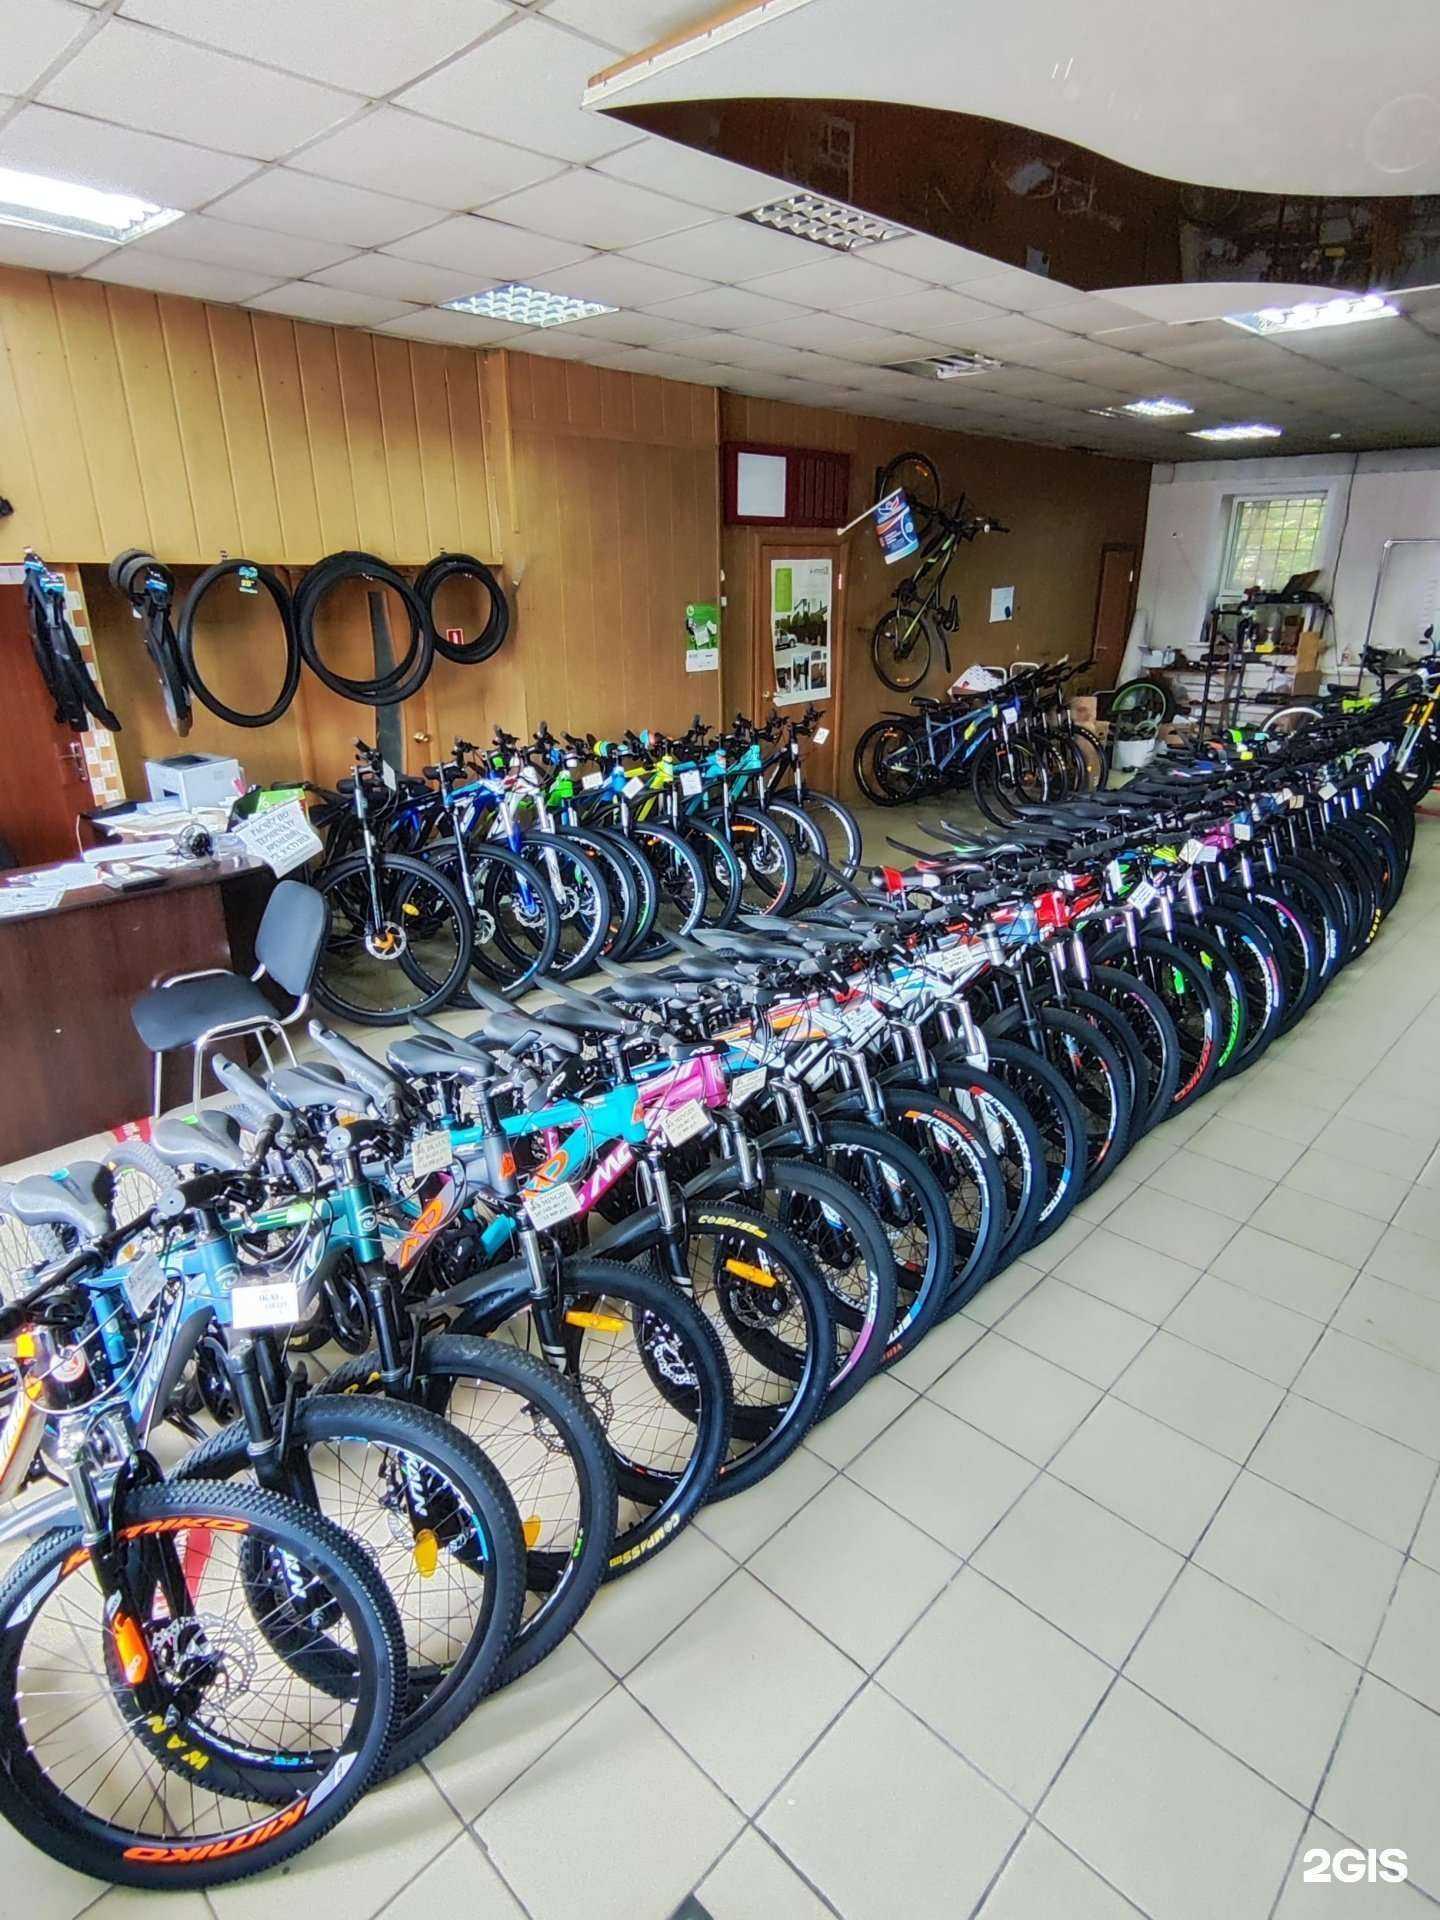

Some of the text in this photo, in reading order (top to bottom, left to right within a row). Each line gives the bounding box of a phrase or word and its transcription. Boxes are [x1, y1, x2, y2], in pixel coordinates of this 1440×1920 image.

[698, 1214, 759, 1233] COMPASS
[622, 1512, 680, 1566] COMPASS
[122, 1800, 308, 1865] KIMIKO
